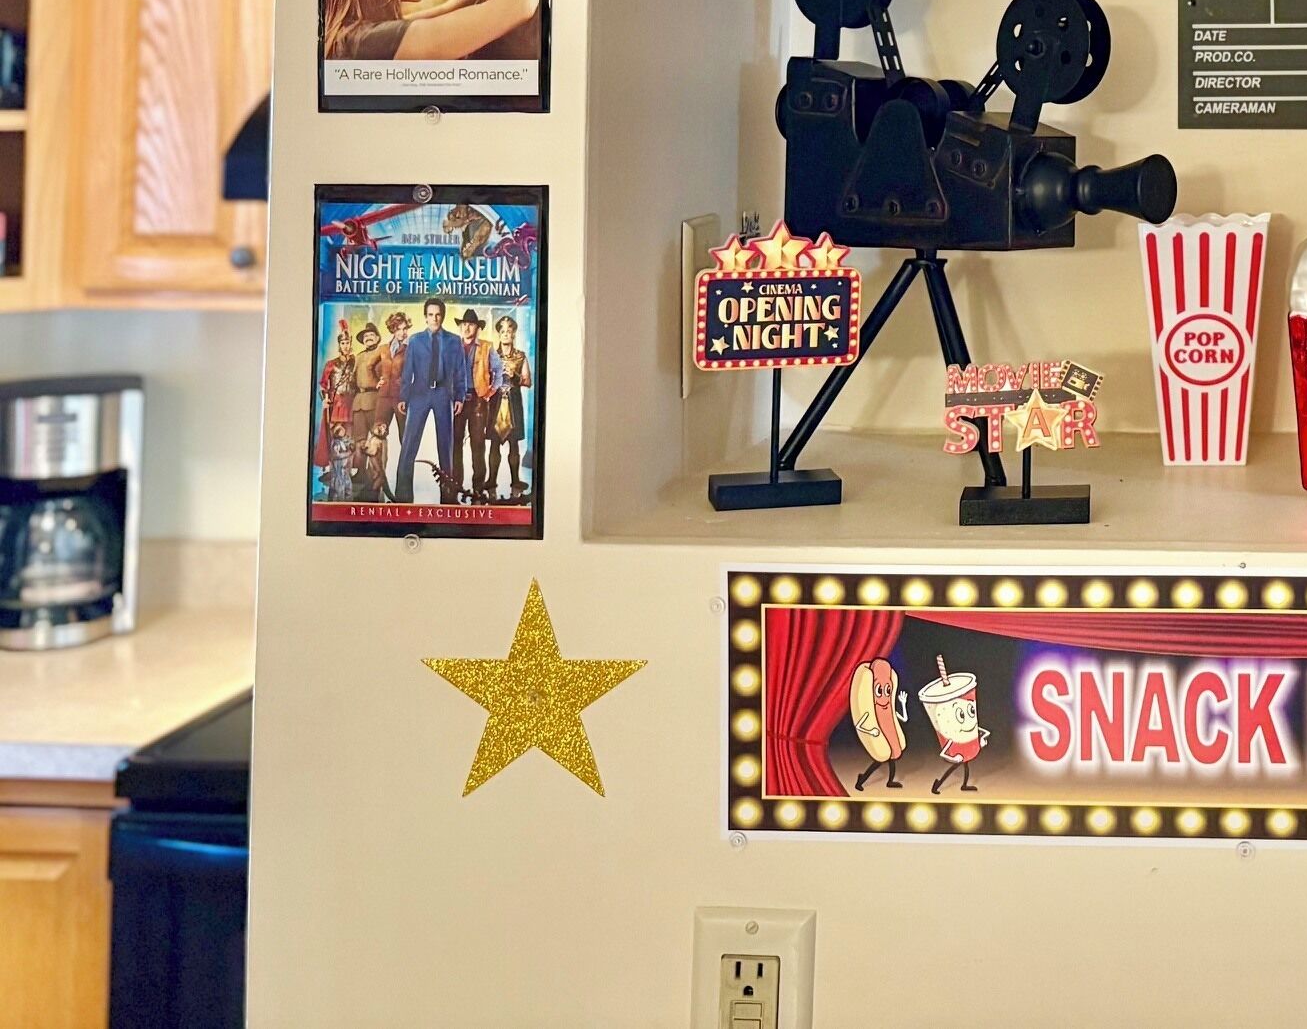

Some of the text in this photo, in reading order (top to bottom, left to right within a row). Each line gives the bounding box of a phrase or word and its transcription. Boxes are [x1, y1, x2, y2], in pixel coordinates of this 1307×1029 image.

[1194, 30, 1227, 42] DATE
[1194, 51, 1256, 63] PROD.CO.
[353, 69, 382, 80] Rare
[387, 68, 455, 81] Hollywood
[1195, 77, 1261, 89] DIRECTOR
[1195, 102, 1276, 114] CAMERAMAN
[336, 253, 404, 280] NIGHT
[409, 255, 423, 267] AT
[429, 254, 520, 282] MUSEUM
[408, 267, 424, 280] THE
[335, 279, 520, 296] BATTLE OF THE SMITHSONIAN
[758, 283, 803, 295] CINEMA
[718, 295, 841, 324] OPENING
[732, 322, 825, 350] NIGHT
[1184, 332, 1225, 346] POP
[1173, 349, 1234, 364] CORN
[946, 362, 1063, 394] MOVIE
[943, 399, 1100, 454] STAR
[350, 506, 493, 519] RENTAL EXCLUSIVE
[1032, 671, 1285, 768] SNACK
